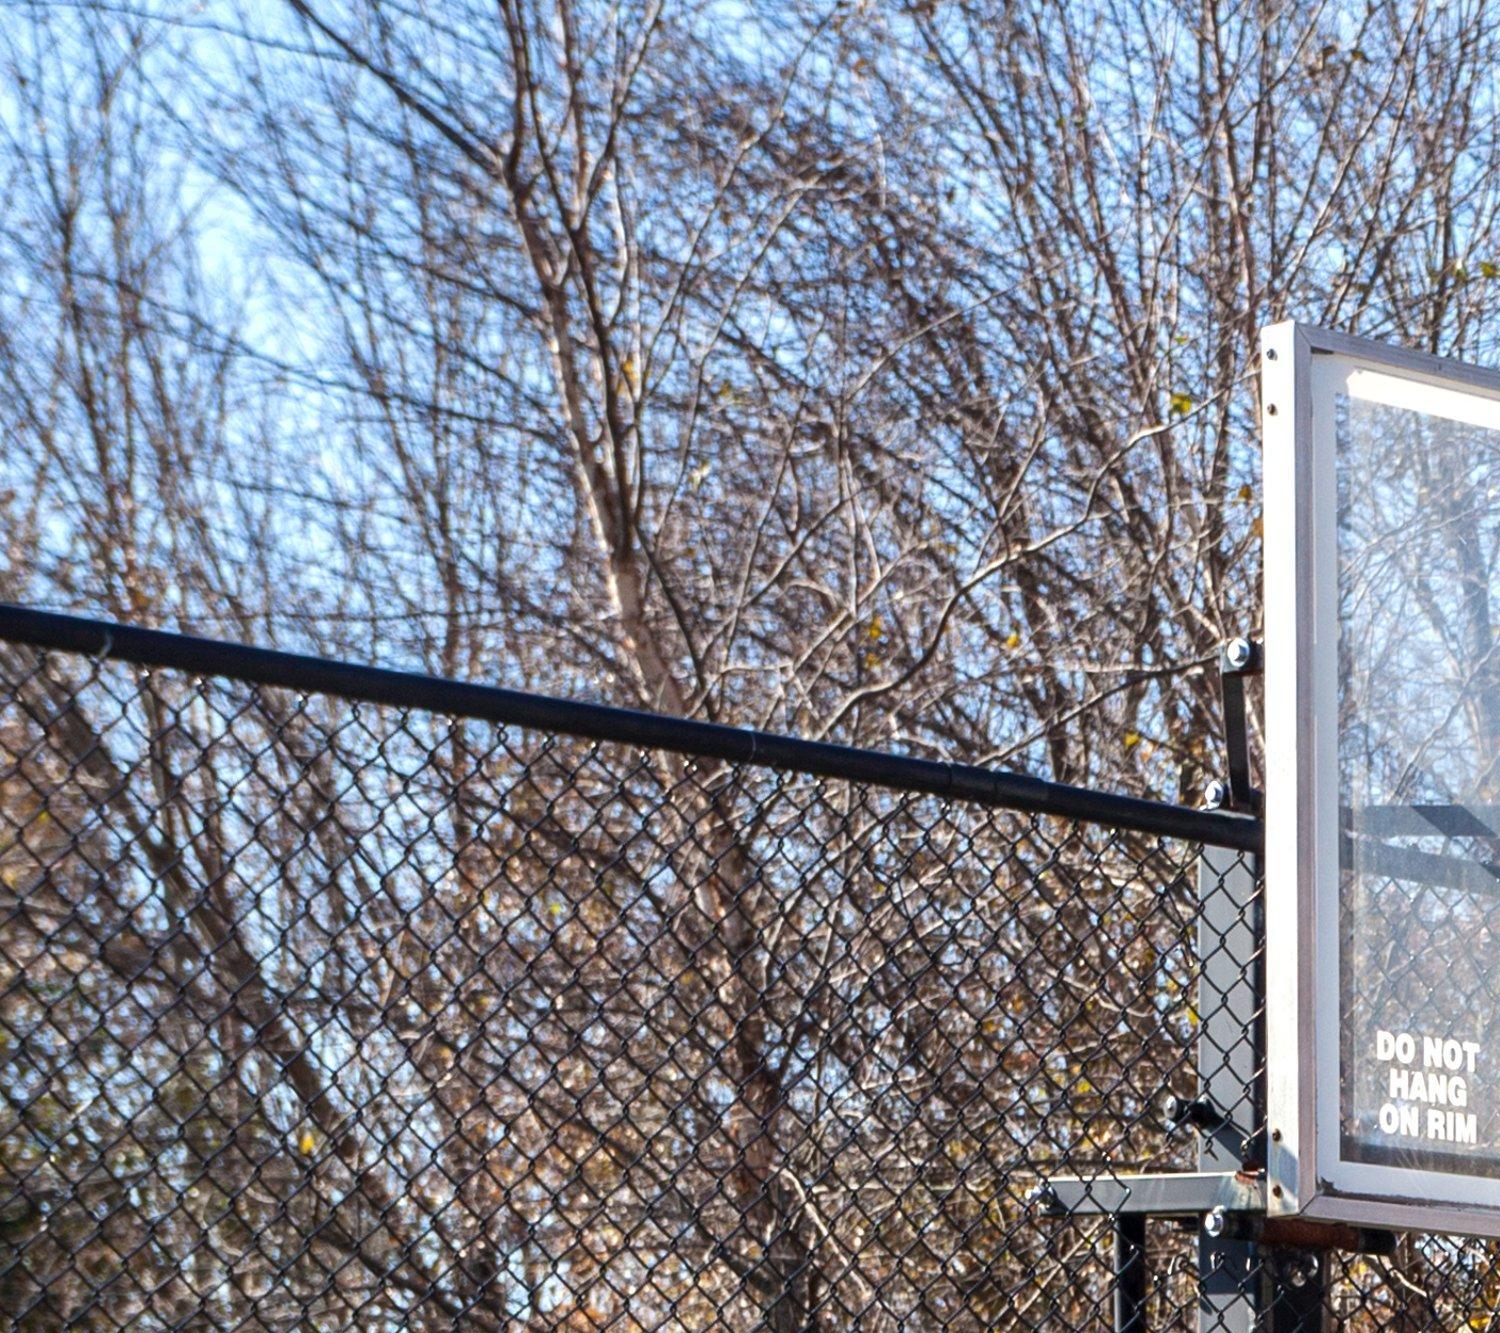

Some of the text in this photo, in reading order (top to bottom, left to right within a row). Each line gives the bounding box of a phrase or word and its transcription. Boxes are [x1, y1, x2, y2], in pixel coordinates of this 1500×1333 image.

[1376, 1030, 1481, 1073] DO NOT
[1389, 1068, 1468, 1107] HANG
[1379, 1103, 1478, 1144] ON RIM
